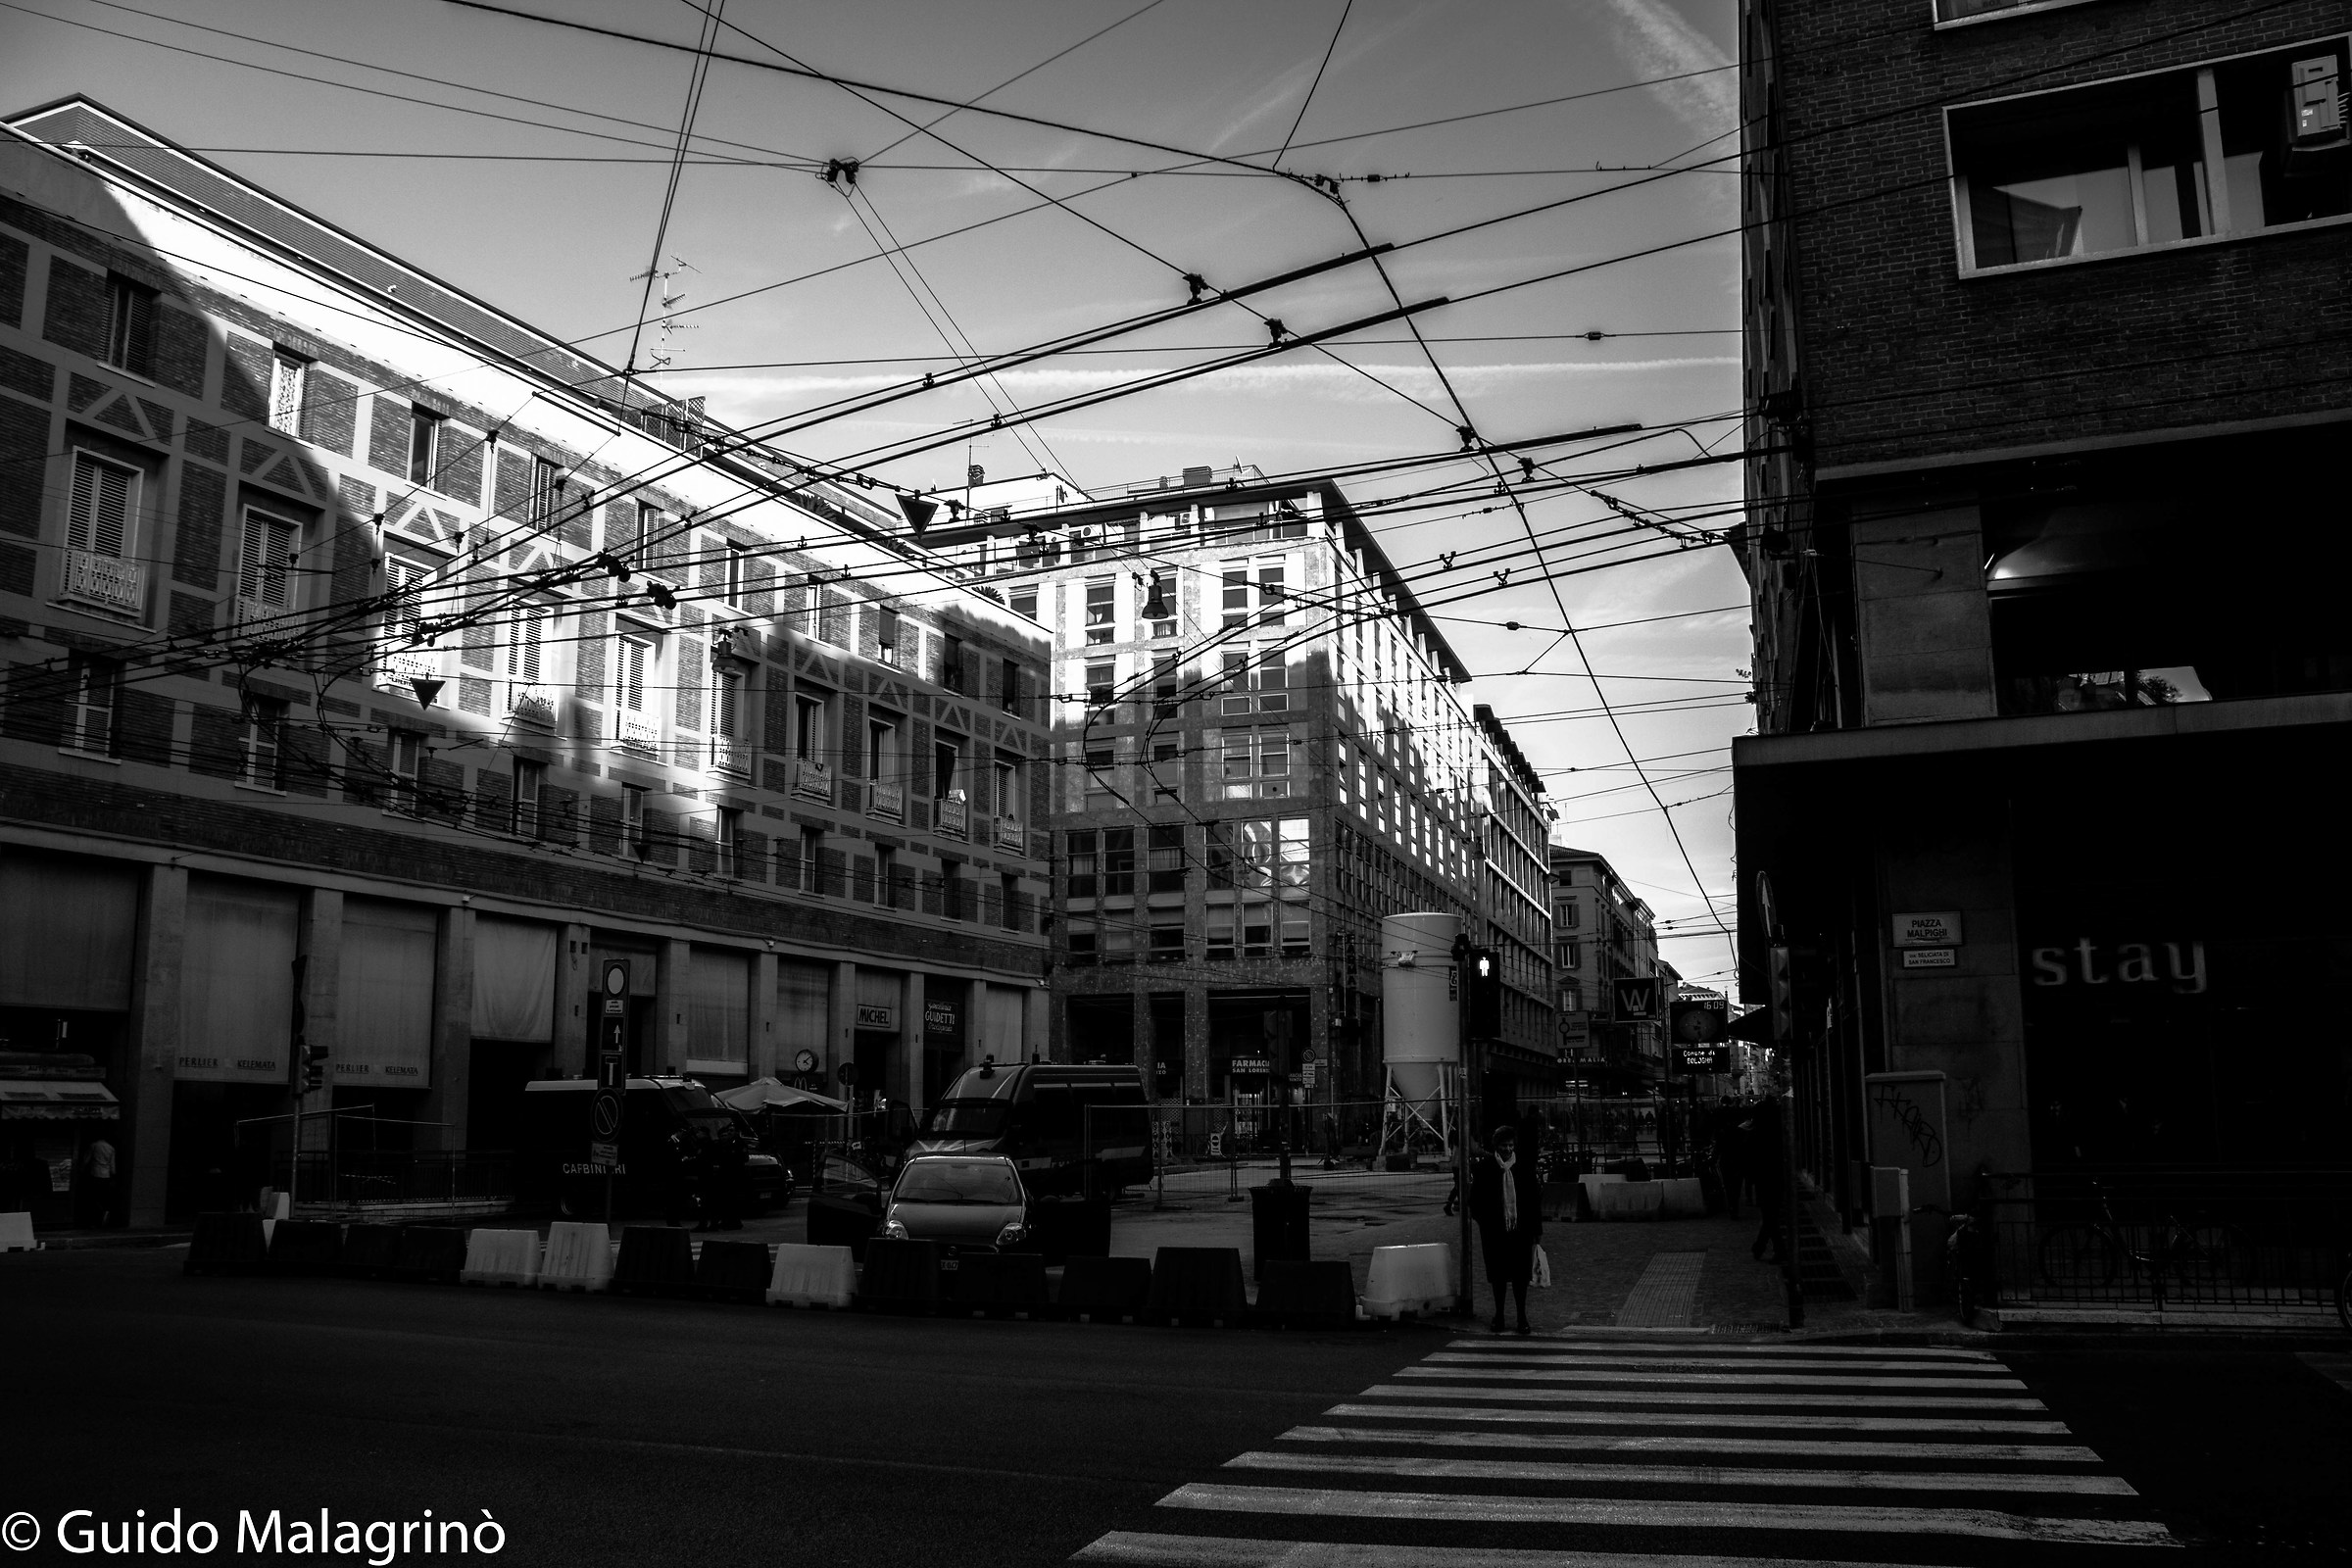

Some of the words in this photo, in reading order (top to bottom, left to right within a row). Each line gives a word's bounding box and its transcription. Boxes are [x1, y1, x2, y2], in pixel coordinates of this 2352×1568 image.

[1907, 928, 1947, 937] MALPIGHI
[2032, 936, 2208, 995] stay
[858, 1007, 889, 1024] MICHEL
[179, 1057, 219, 1067] PERLIER
[237, 1059, 276, 1069] KELEMATA
[336, 1063, 369, 1073] PERLIER
[385, 1065, 418, 1075] KELEMATA
